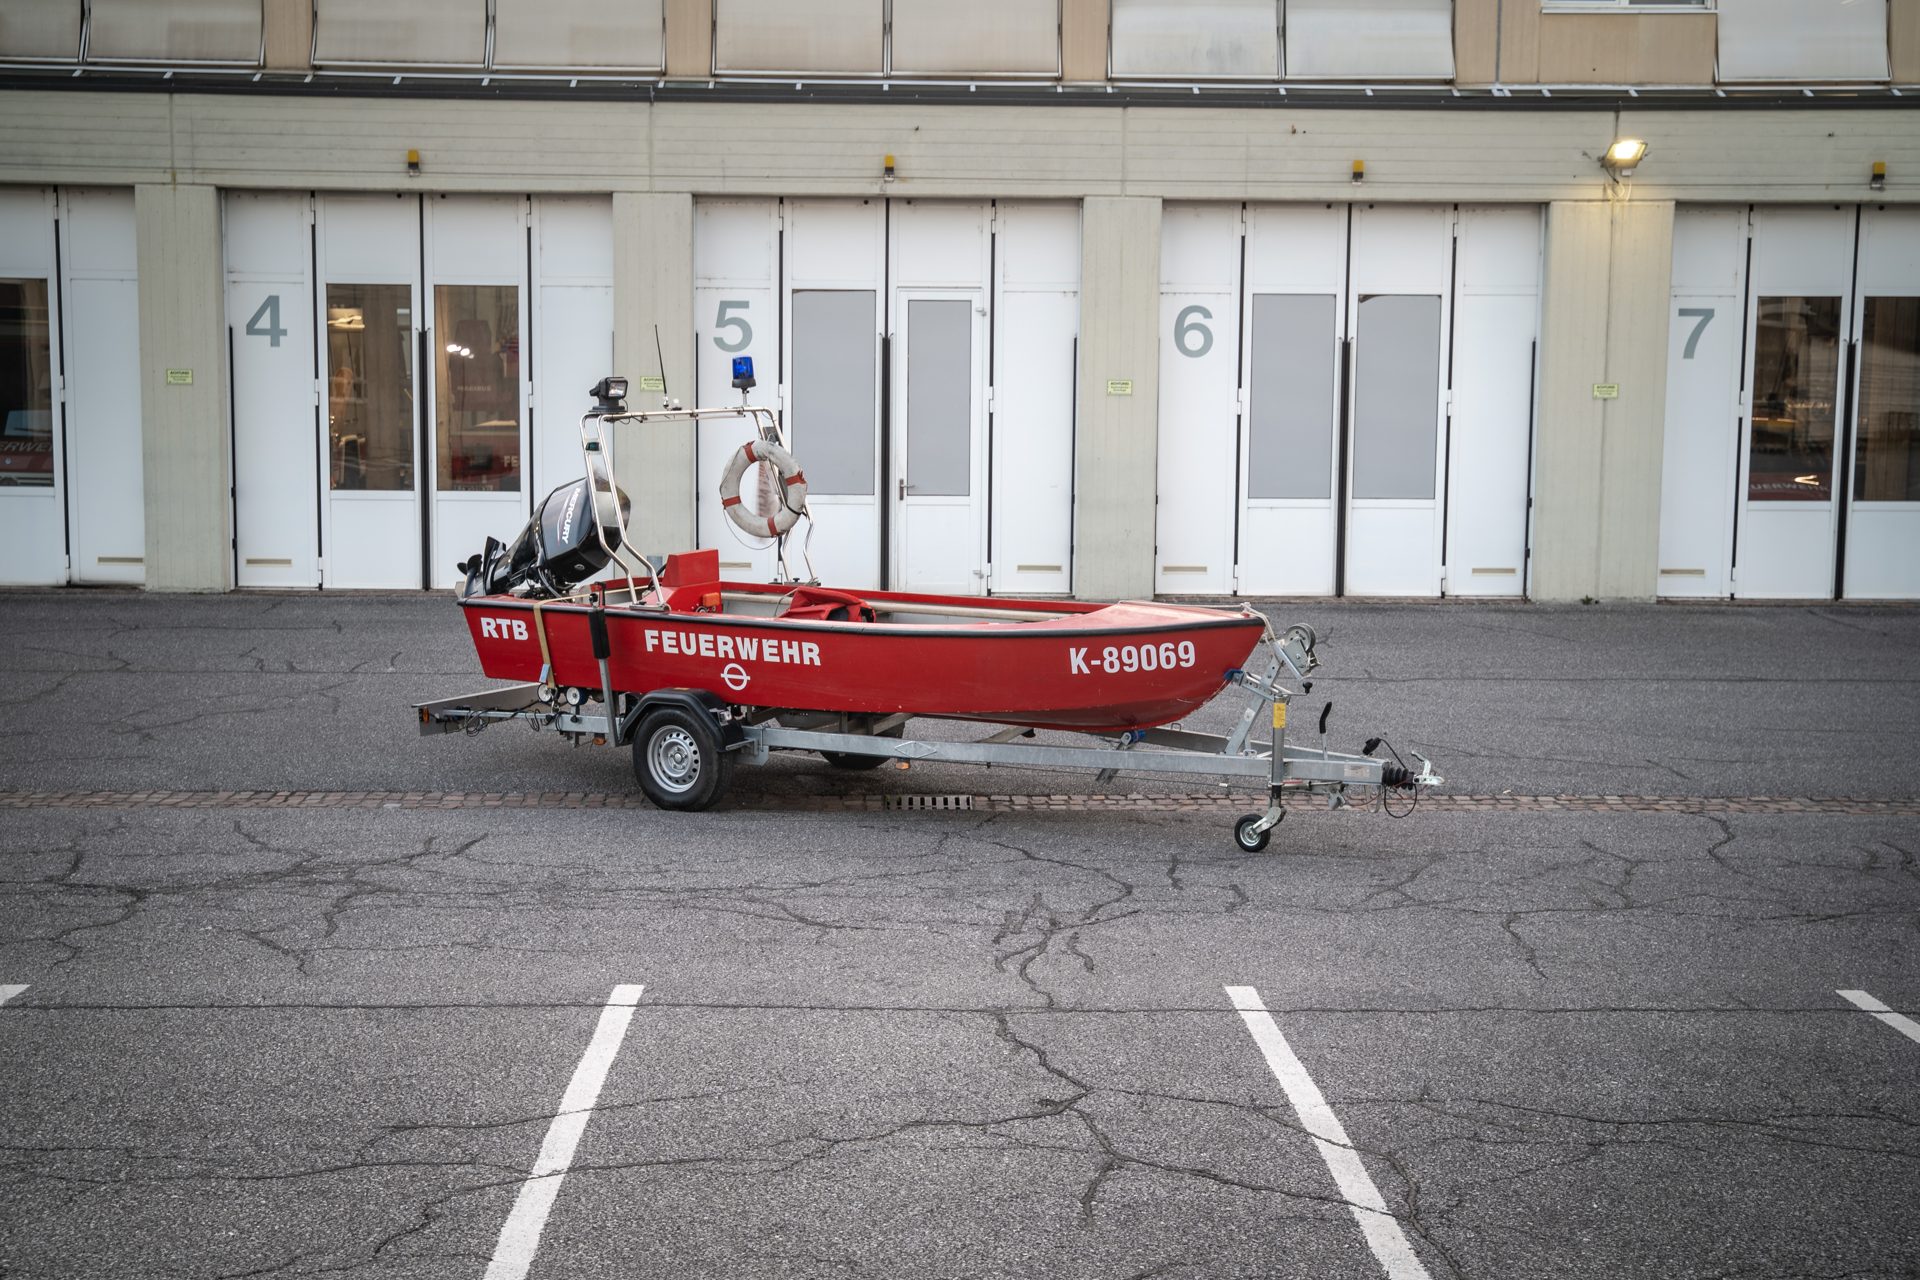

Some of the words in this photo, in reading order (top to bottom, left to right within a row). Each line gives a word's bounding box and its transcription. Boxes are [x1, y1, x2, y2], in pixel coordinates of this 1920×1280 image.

[246, 295, 287, 347] 4
[713, 301, 752, 352] 5
[1174, 305, 1213, 357] 6
[1678, 308, 1715, 359] 7
[562, 488, 581, 545] MERCURY
[480, 617, 529, 641] RTB
[644, 629, 821, 667] FEUERWEHR
[1069, 640, 1196, 675] K-89069
